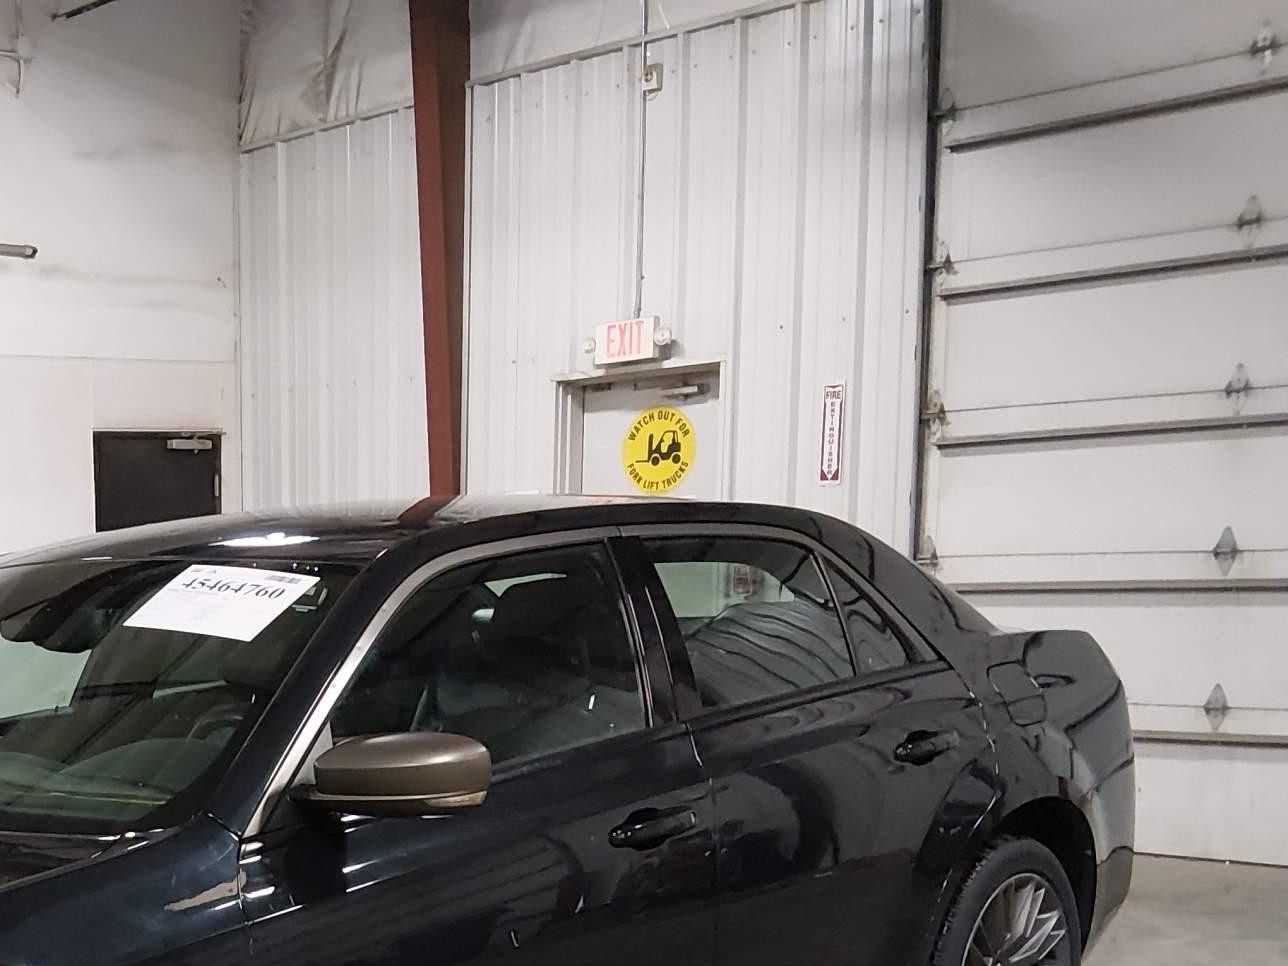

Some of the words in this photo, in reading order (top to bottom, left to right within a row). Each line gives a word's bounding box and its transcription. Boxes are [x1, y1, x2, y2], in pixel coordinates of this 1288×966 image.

[606, 320, 645, 358] EXIT
[826, 390, 842, 400] FIRE
[627, 412, 655, 441] WATCH
[657, 410, 675, 422] OUT
[675, 418, 691, 438] FOR
[826, 401, 836, 475] EXTINGUISHER
[627, 463, 643, 485] FORK
[642, 480, 660, 490] LIFT
[662, 461, 689, 489] TRUCKS
[181, 576, 287, 599] 45464760
